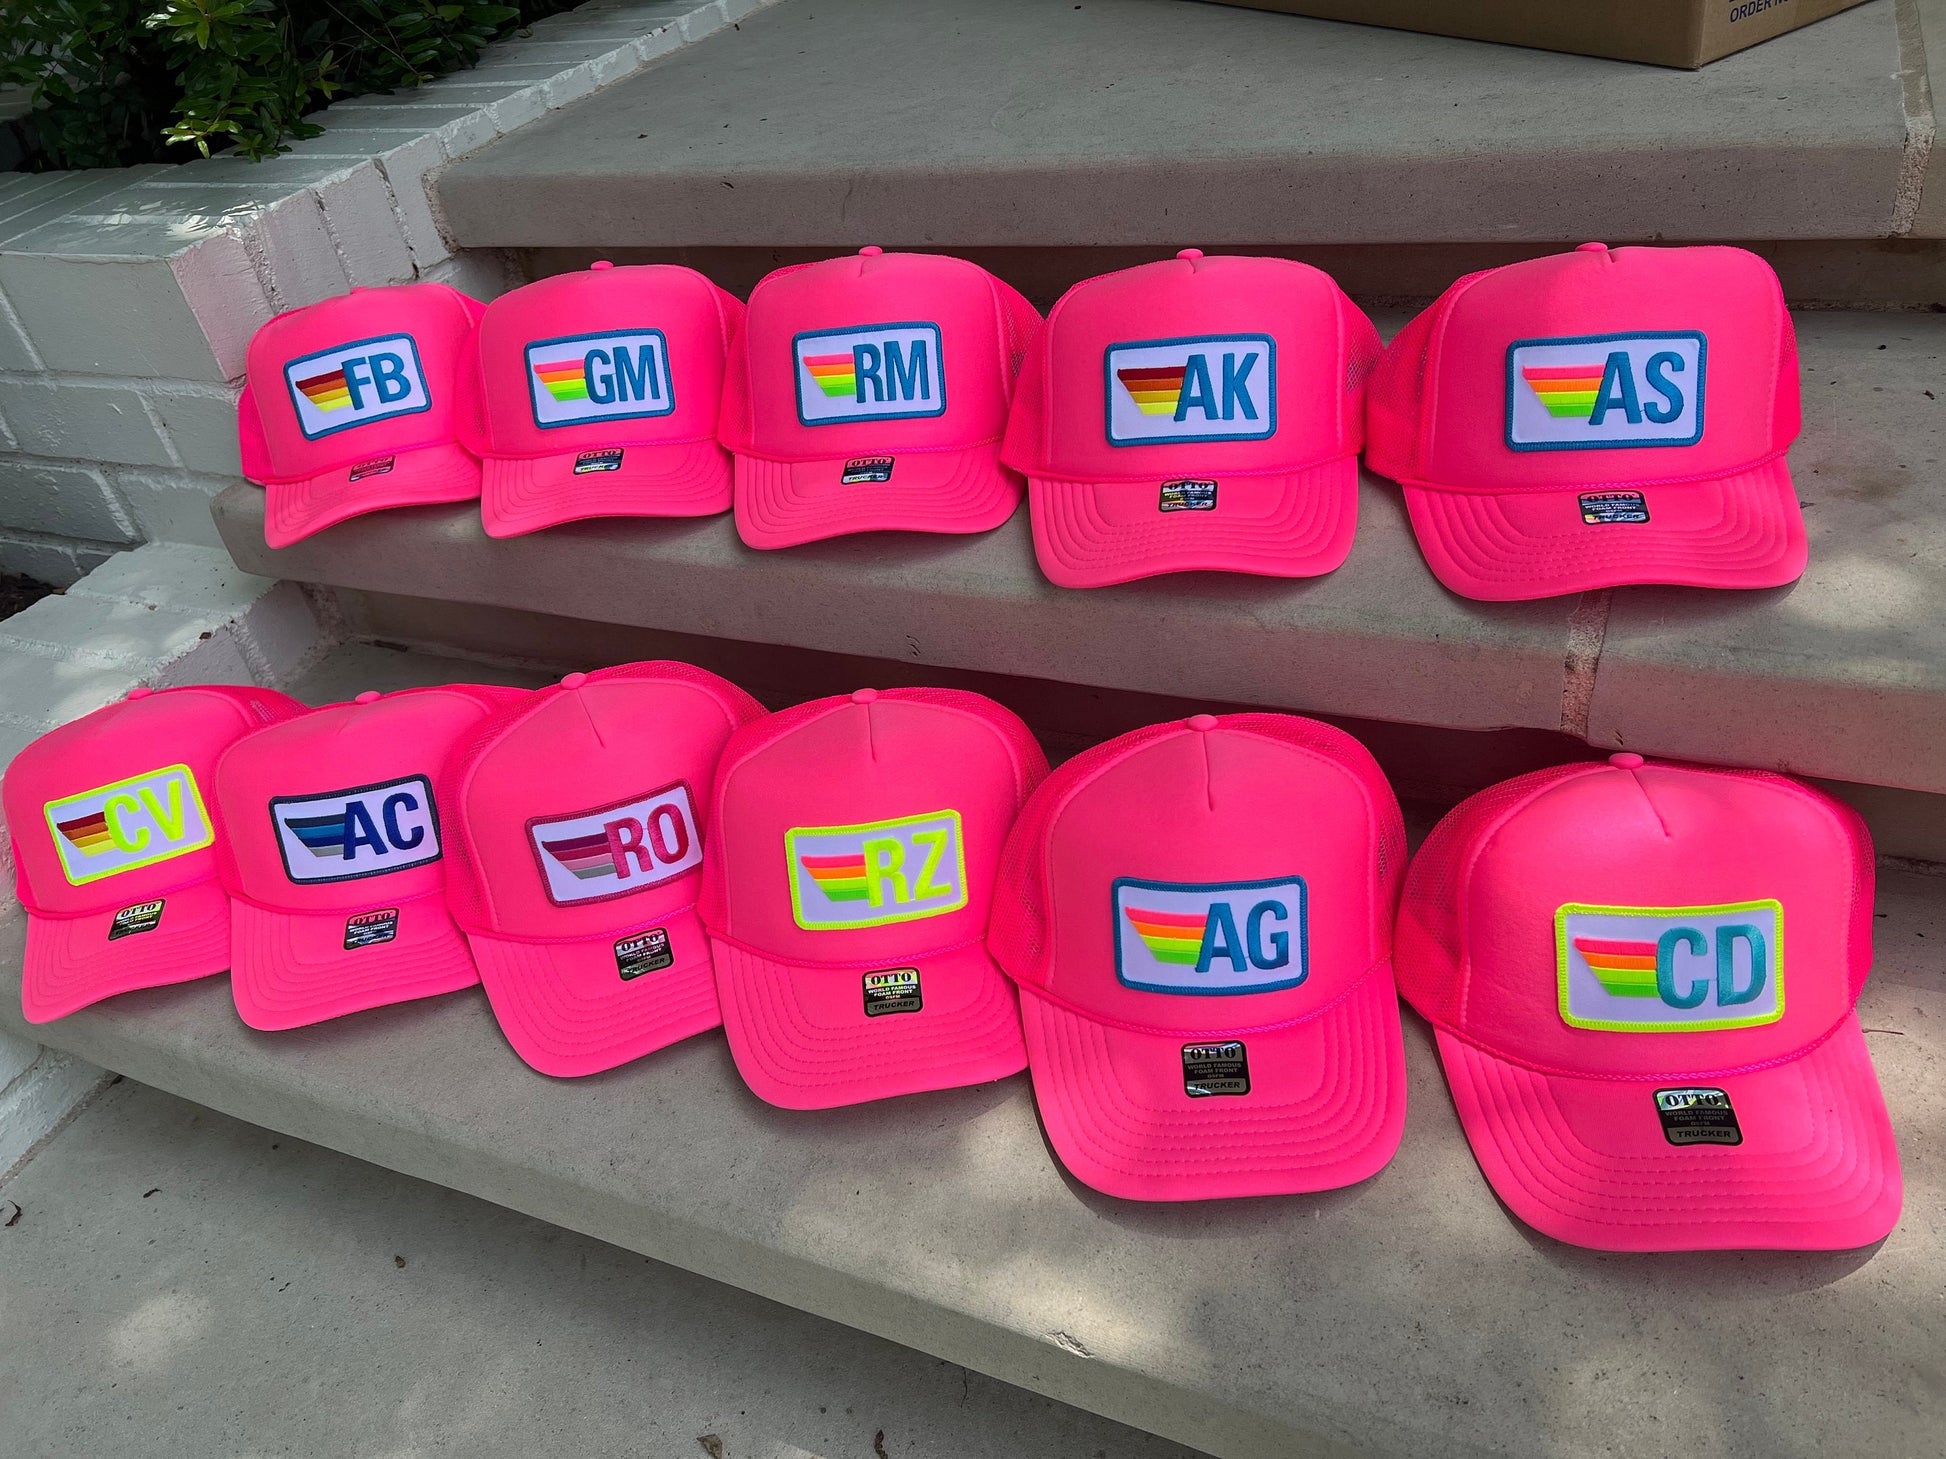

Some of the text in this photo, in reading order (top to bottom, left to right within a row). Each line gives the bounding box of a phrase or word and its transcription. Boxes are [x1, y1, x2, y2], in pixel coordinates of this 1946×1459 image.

[1730, 0, 1771, 22] ORDER
[341, 352, 412, 410] FB
[584, 344, 660, 404] GM
[853, 340, 930, 403] RM
[1174, 352, 1260, 422] AK
[1588, 351, 1685, 425] AS
[103, 779, 185, 853] CV
[343, 792, 425, 860] AC
[603, 803, 690, 880] RO
[862, 828, 952, 908] RZ
[121, 903, 156, 917] OTTO
[354, 912, 391, 925] OTTO
[1195, 900, 1290, 972] AG
[621, 934, 659, 951] OTTO
[1656, 924, 1767, 1009] CD
[871, 972, 911, 985] OTTO
[873, 1000, 915, 1011] TRUCKER
[1190, 1047, 1236, 1060] OTTO
[1194, 1081, 1240, 1090] TRUCKER
[1665, 1094, 1720, 1107] OTTO
[1677, 1130, 1731, 1138] TRUCKER
